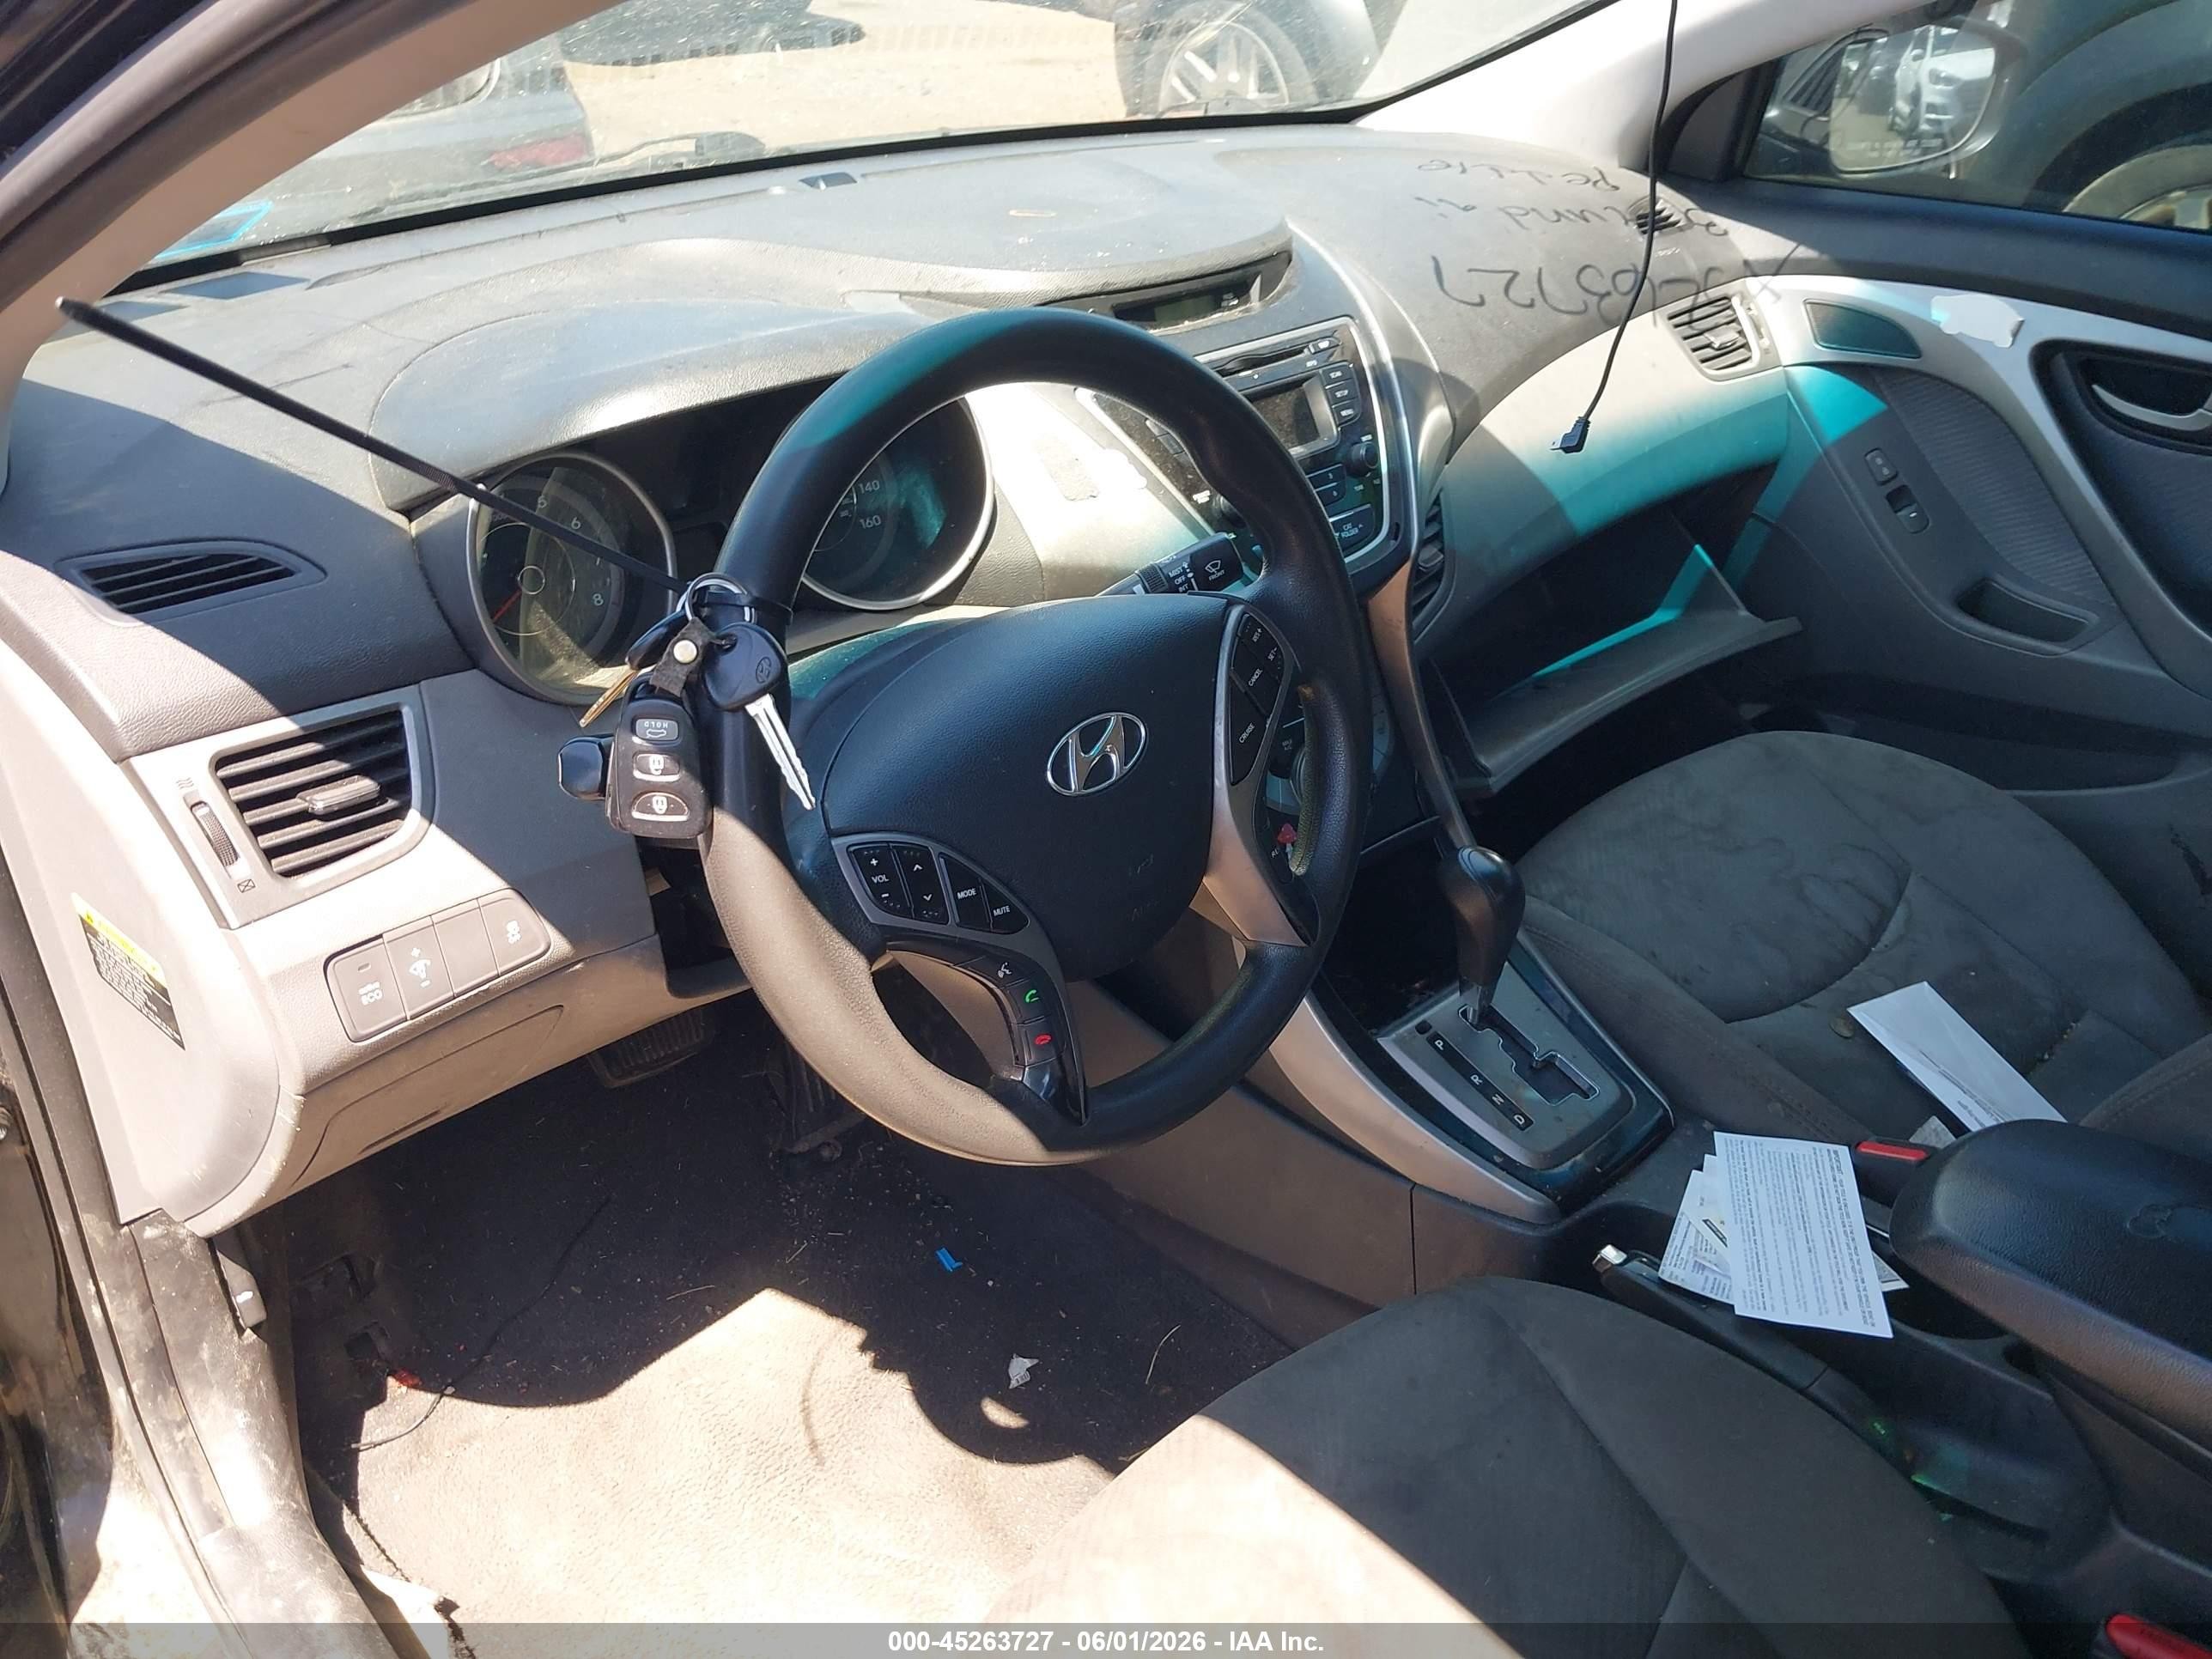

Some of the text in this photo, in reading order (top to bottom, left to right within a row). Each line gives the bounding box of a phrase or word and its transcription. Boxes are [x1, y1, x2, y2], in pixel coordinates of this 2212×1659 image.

[858, 479, 880, 495] 140
[570, 516, 582, 530] 6
[859, 514, 882, 530] 160
[1168, 567, 1184, 578] MIST
[1208, 569, 1225, 581] FRONT
[1174, 574, 1187, 586] OFF
[592, 592, 605, 606] 8
[1248, 668, 1264, 687] CANCEL
[643, 720, 669, 729] HOLD
[1238, 721, 1256, 744] CRUISE
[871, 874, 890, 884] VOL
[957, 887, 978, 900] MODE
[993, 905, 1012, 917] MUTE
[361, 988, 383, 1006] ECO
[1434, 1039, 1526, 1126] P R N D
